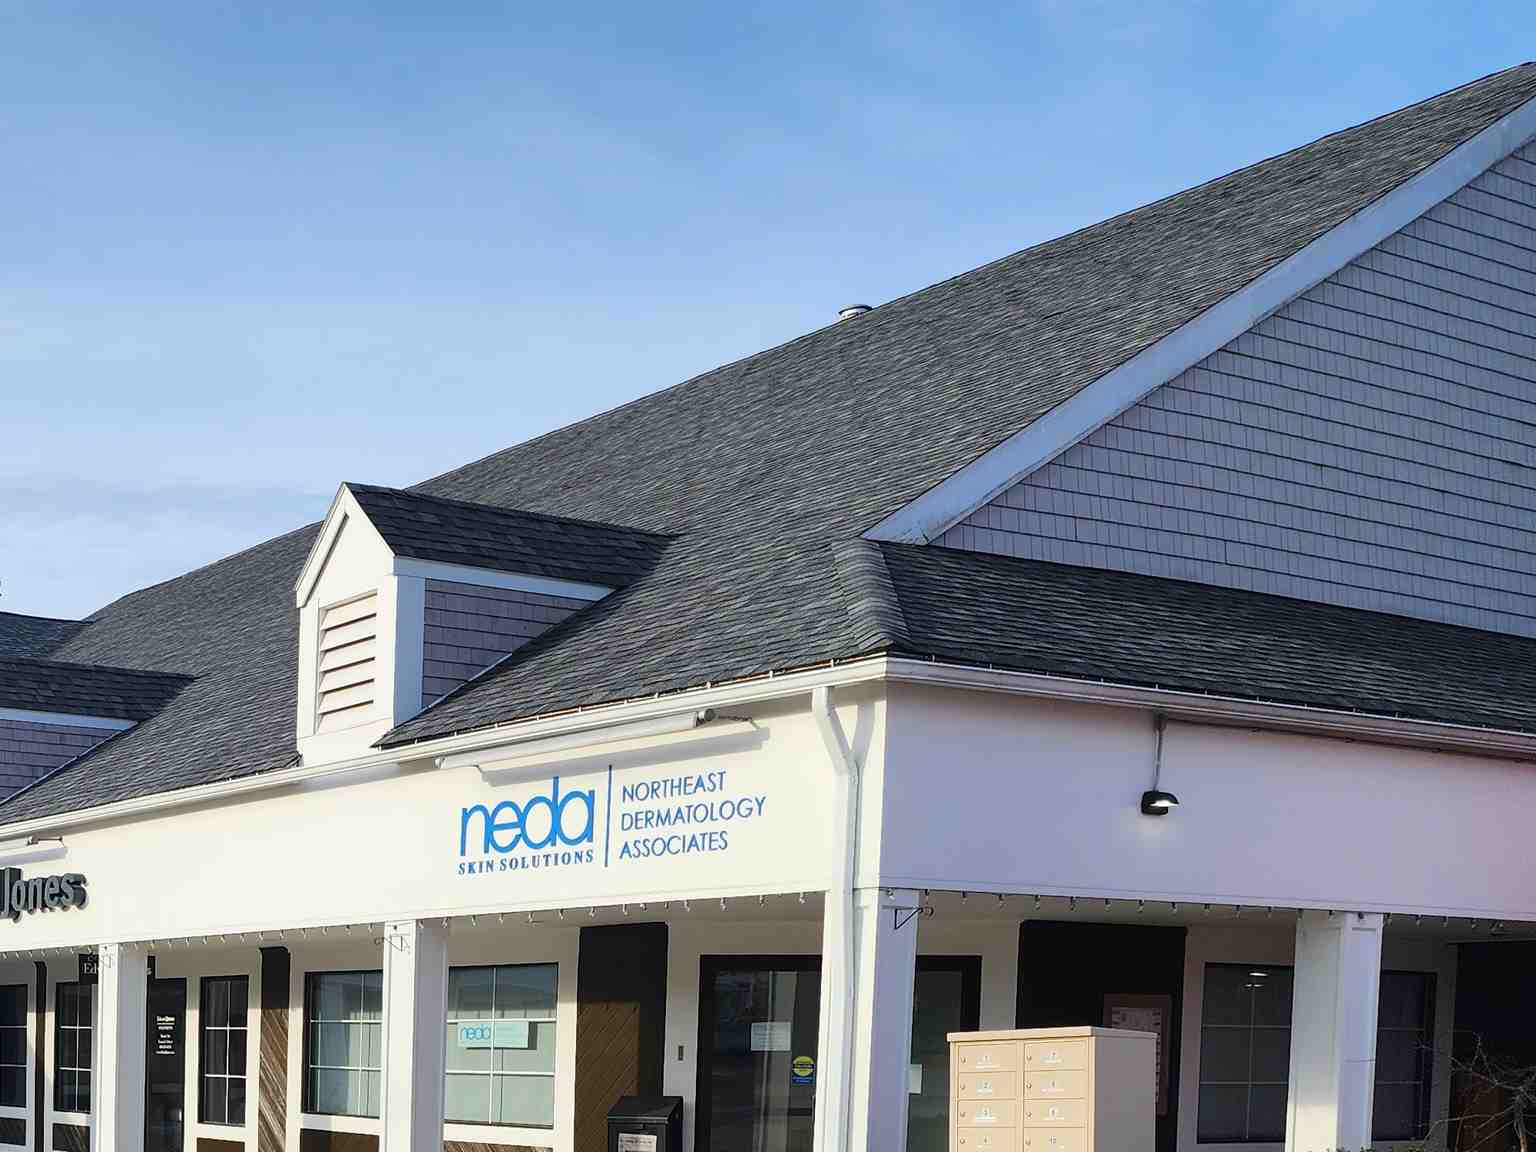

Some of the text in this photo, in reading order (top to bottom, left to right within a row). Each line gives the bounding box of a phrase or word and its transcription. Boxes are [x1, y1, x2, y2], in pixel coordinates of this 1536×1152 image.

[622, 771, 726, 803] NORTHEAST
[460, 776, 595, 856] neda
[620, 796, 766, 831] DERMATOLOGY
[619, 831, 728, 859] ASSOCIATES
[458, 849, 594, 875] SKIN SOLUTIONS
[0, 867, 88, 923] Jones
